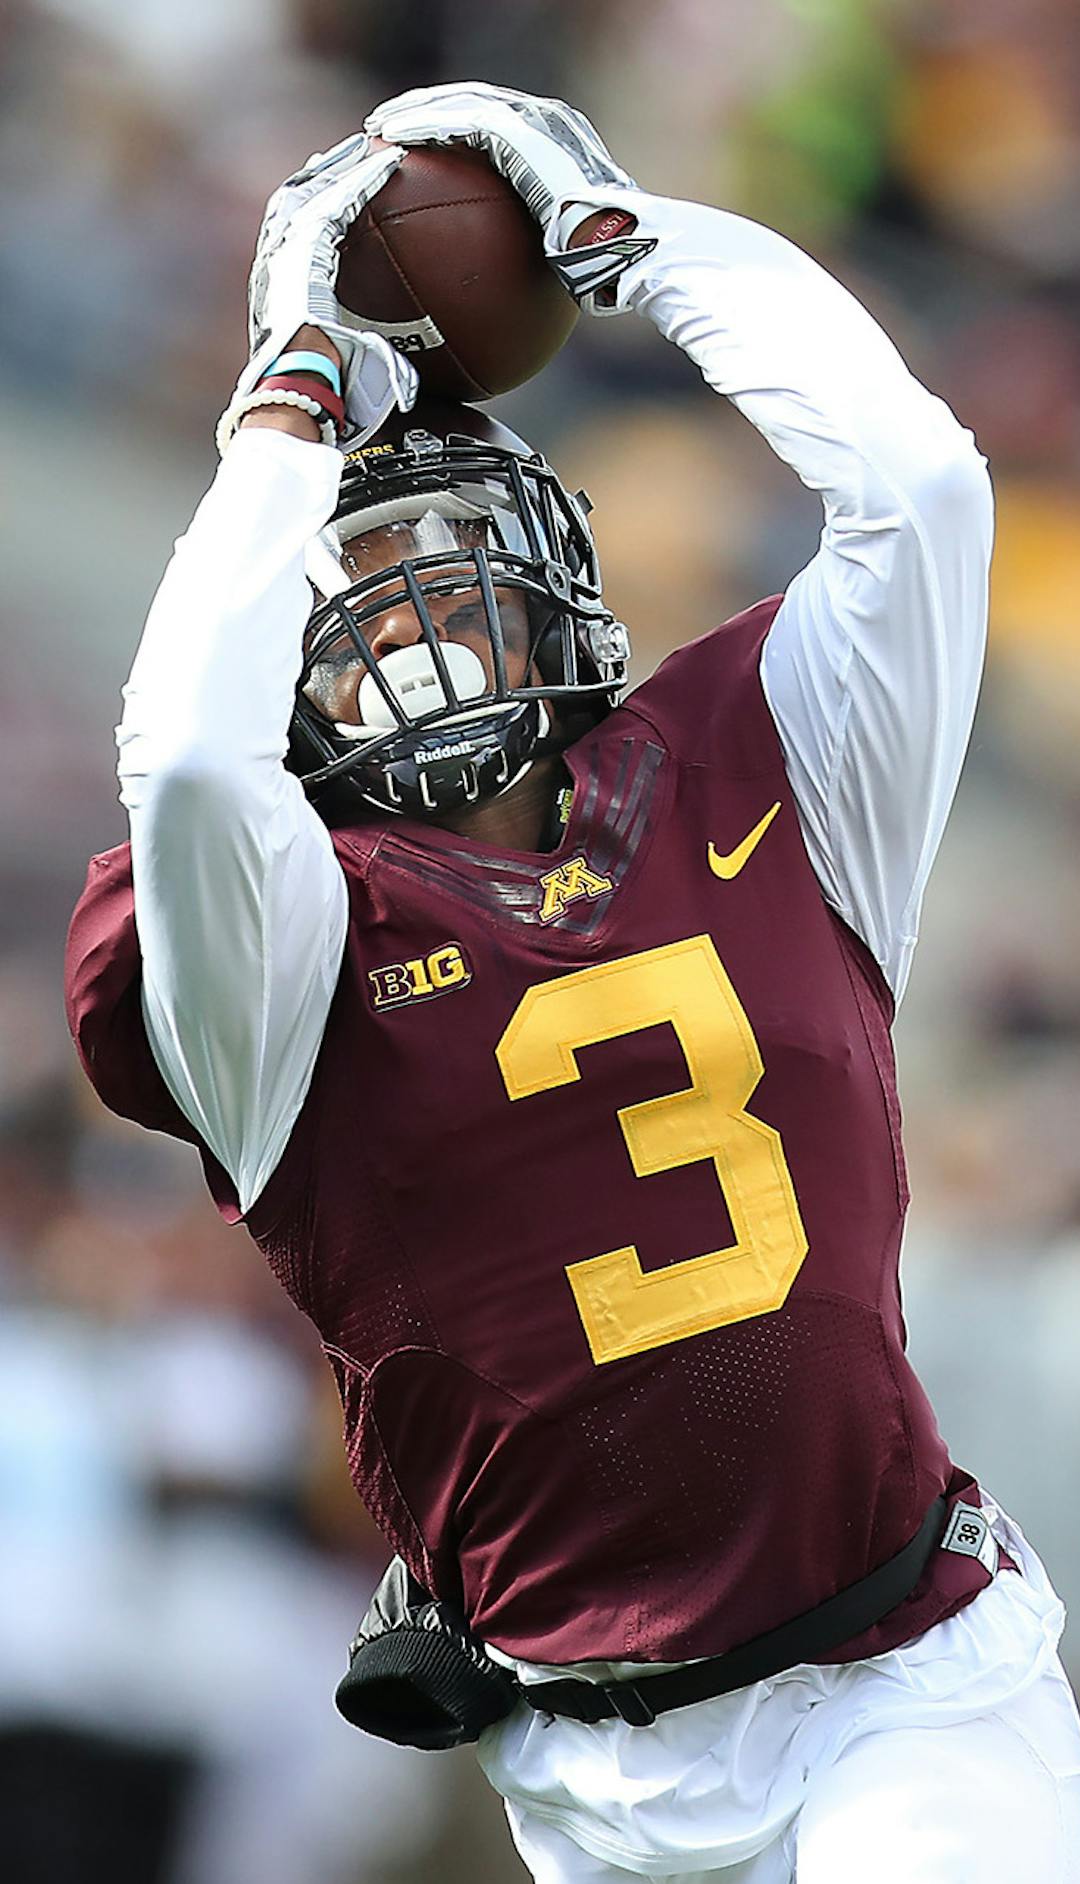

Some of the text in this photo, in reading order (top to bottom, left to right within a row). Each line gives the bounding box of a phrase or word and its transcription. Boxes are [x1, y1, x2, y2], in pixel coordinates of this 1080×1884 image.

[539, 856, 613, 922] M
[495, 933, 809, 1366] 3
[957, 1522, 981, 1545] 38
